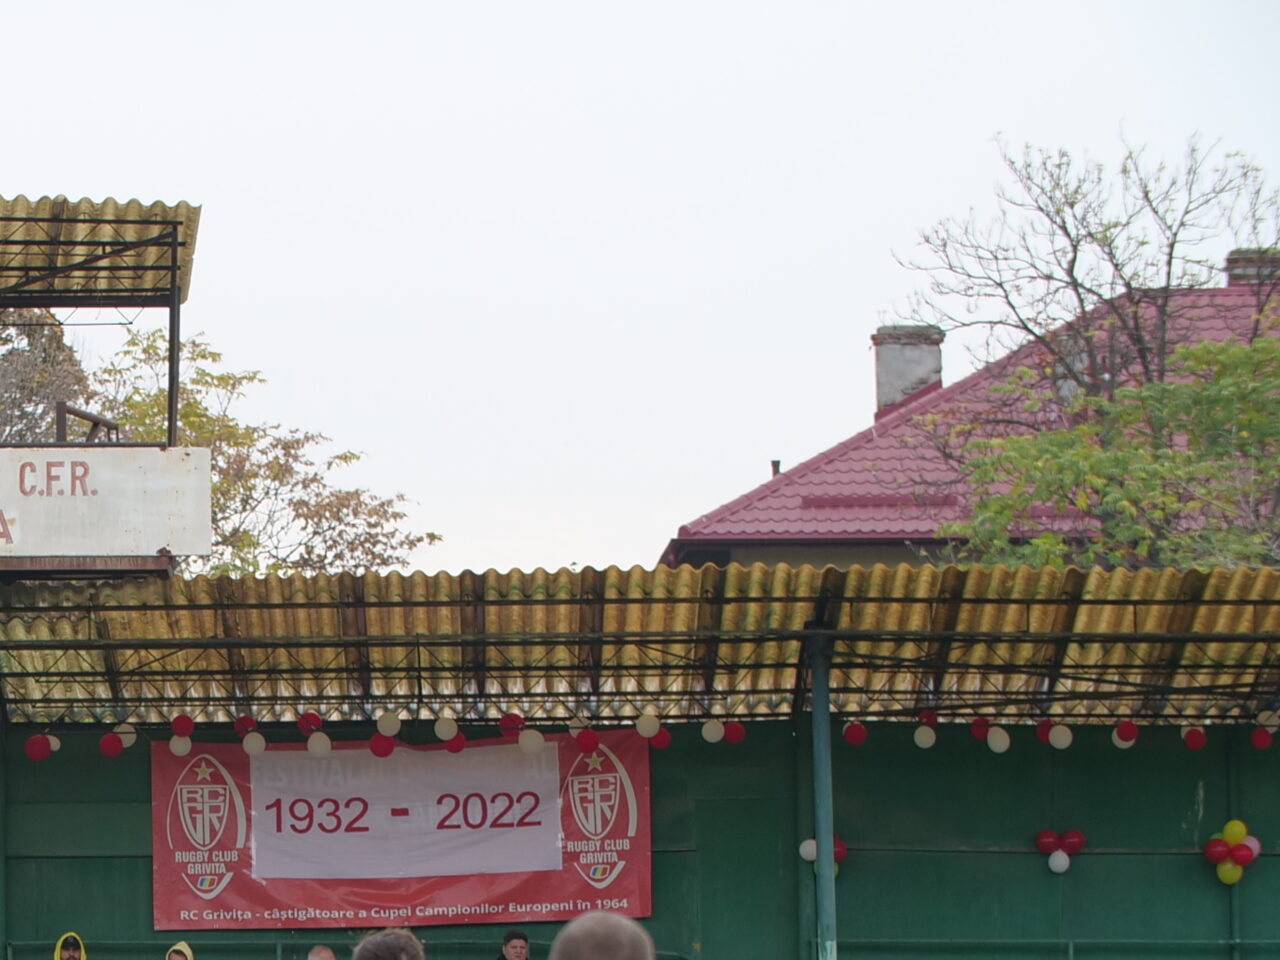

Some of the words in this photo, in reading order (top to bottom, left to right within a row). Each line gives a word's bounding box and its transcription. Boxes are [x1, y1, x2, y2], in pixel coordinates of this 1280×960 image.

[19, 461, 98, 497] C.F.R.
[265, 797, 370, 834] 1932
[436, 791, 542, 829] 2022
[175, 850, 209, 863] RUGBY
[212, 850, 238, 862] CLUB
[567, 840, 601, 852] RUGBY
[604, 839, 630, 851] CLUB
[180, 910, 198, 920] RC
[358, 910, 367, 918] a
[371, 907, 412, 919] Cupei
[415, 903, 504, 918] Campionilor
[508, 900, 573, 914] Europeni
[577, 899, 591, 910] în
[595, 898, 629, 910] 1964
